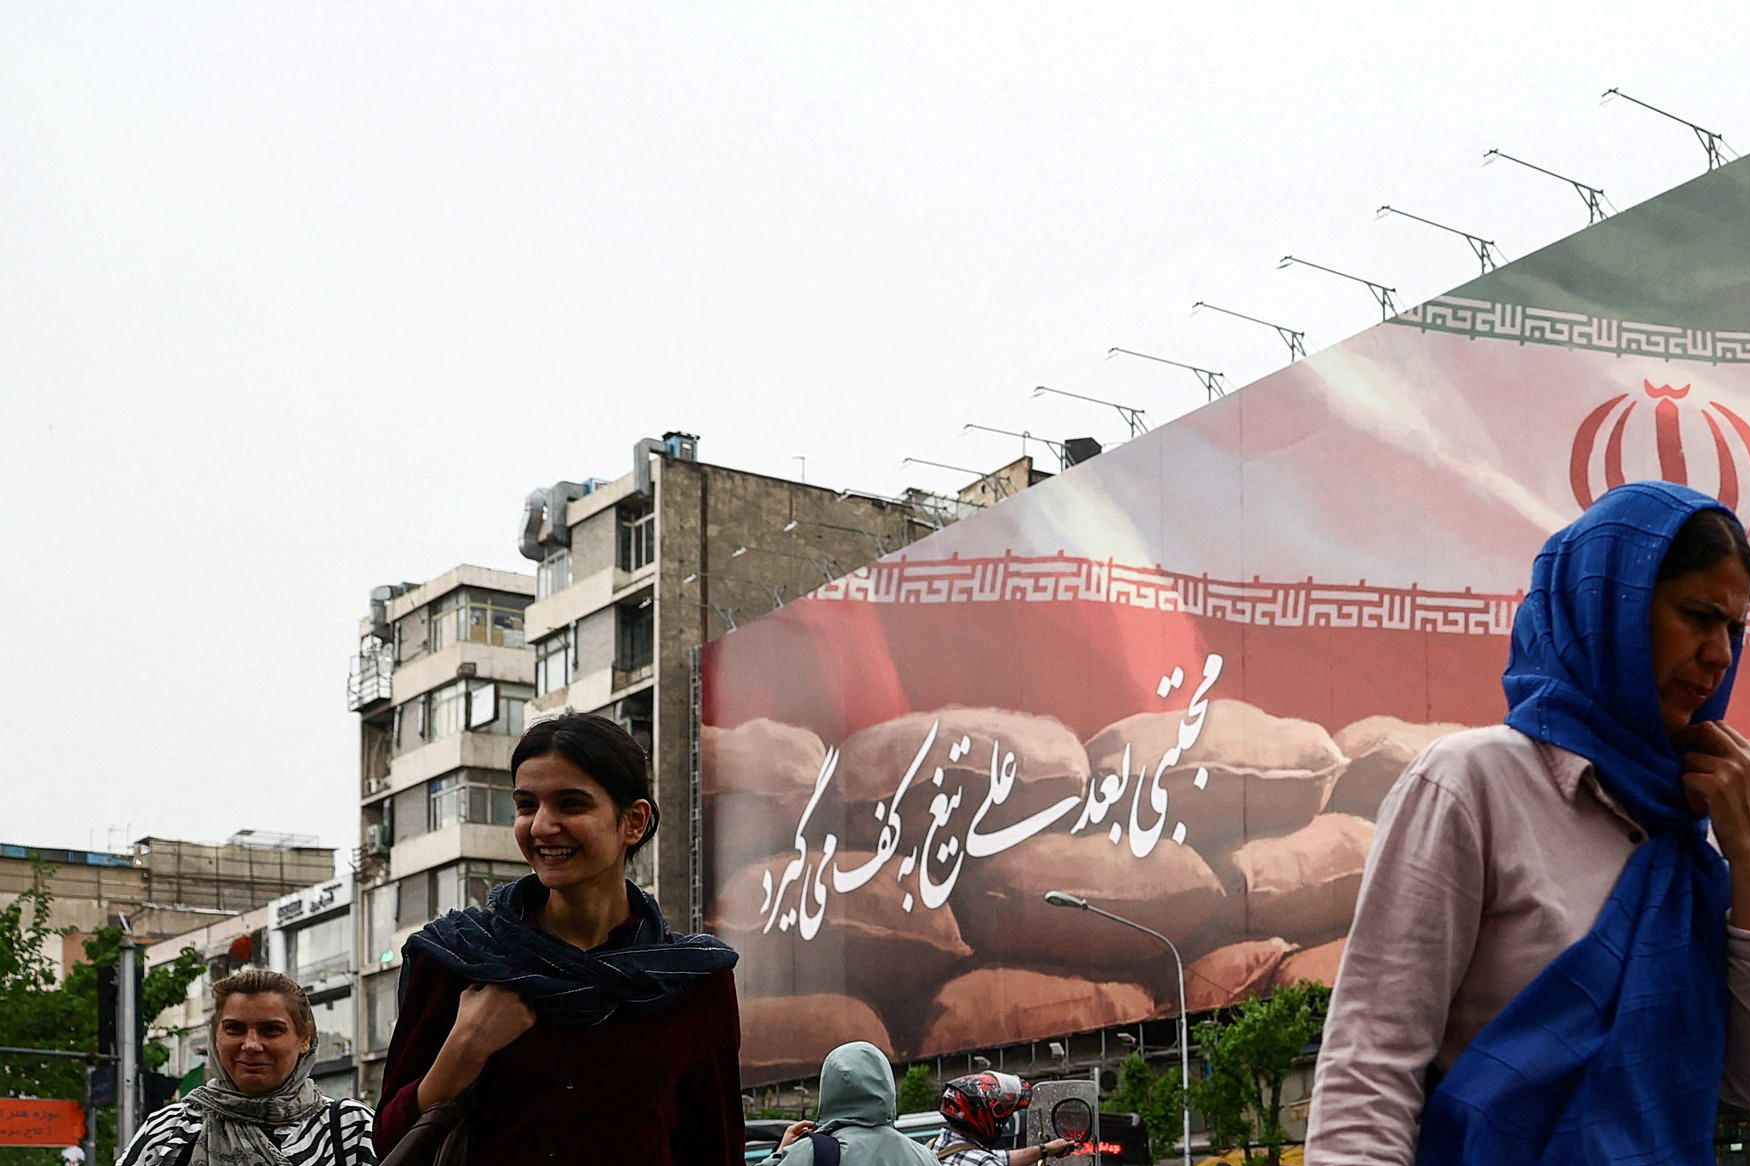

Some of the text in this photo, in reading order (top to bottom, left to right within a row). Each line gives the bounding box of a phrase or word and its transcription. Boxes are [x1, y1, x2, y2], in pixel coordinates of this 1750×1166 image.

[833, 719, 939, 893] کف
[919, 735, 971, 909] تیغ
[1129, 653, 1223, 858] مجتبی
[896, 846, 917, 912] به
